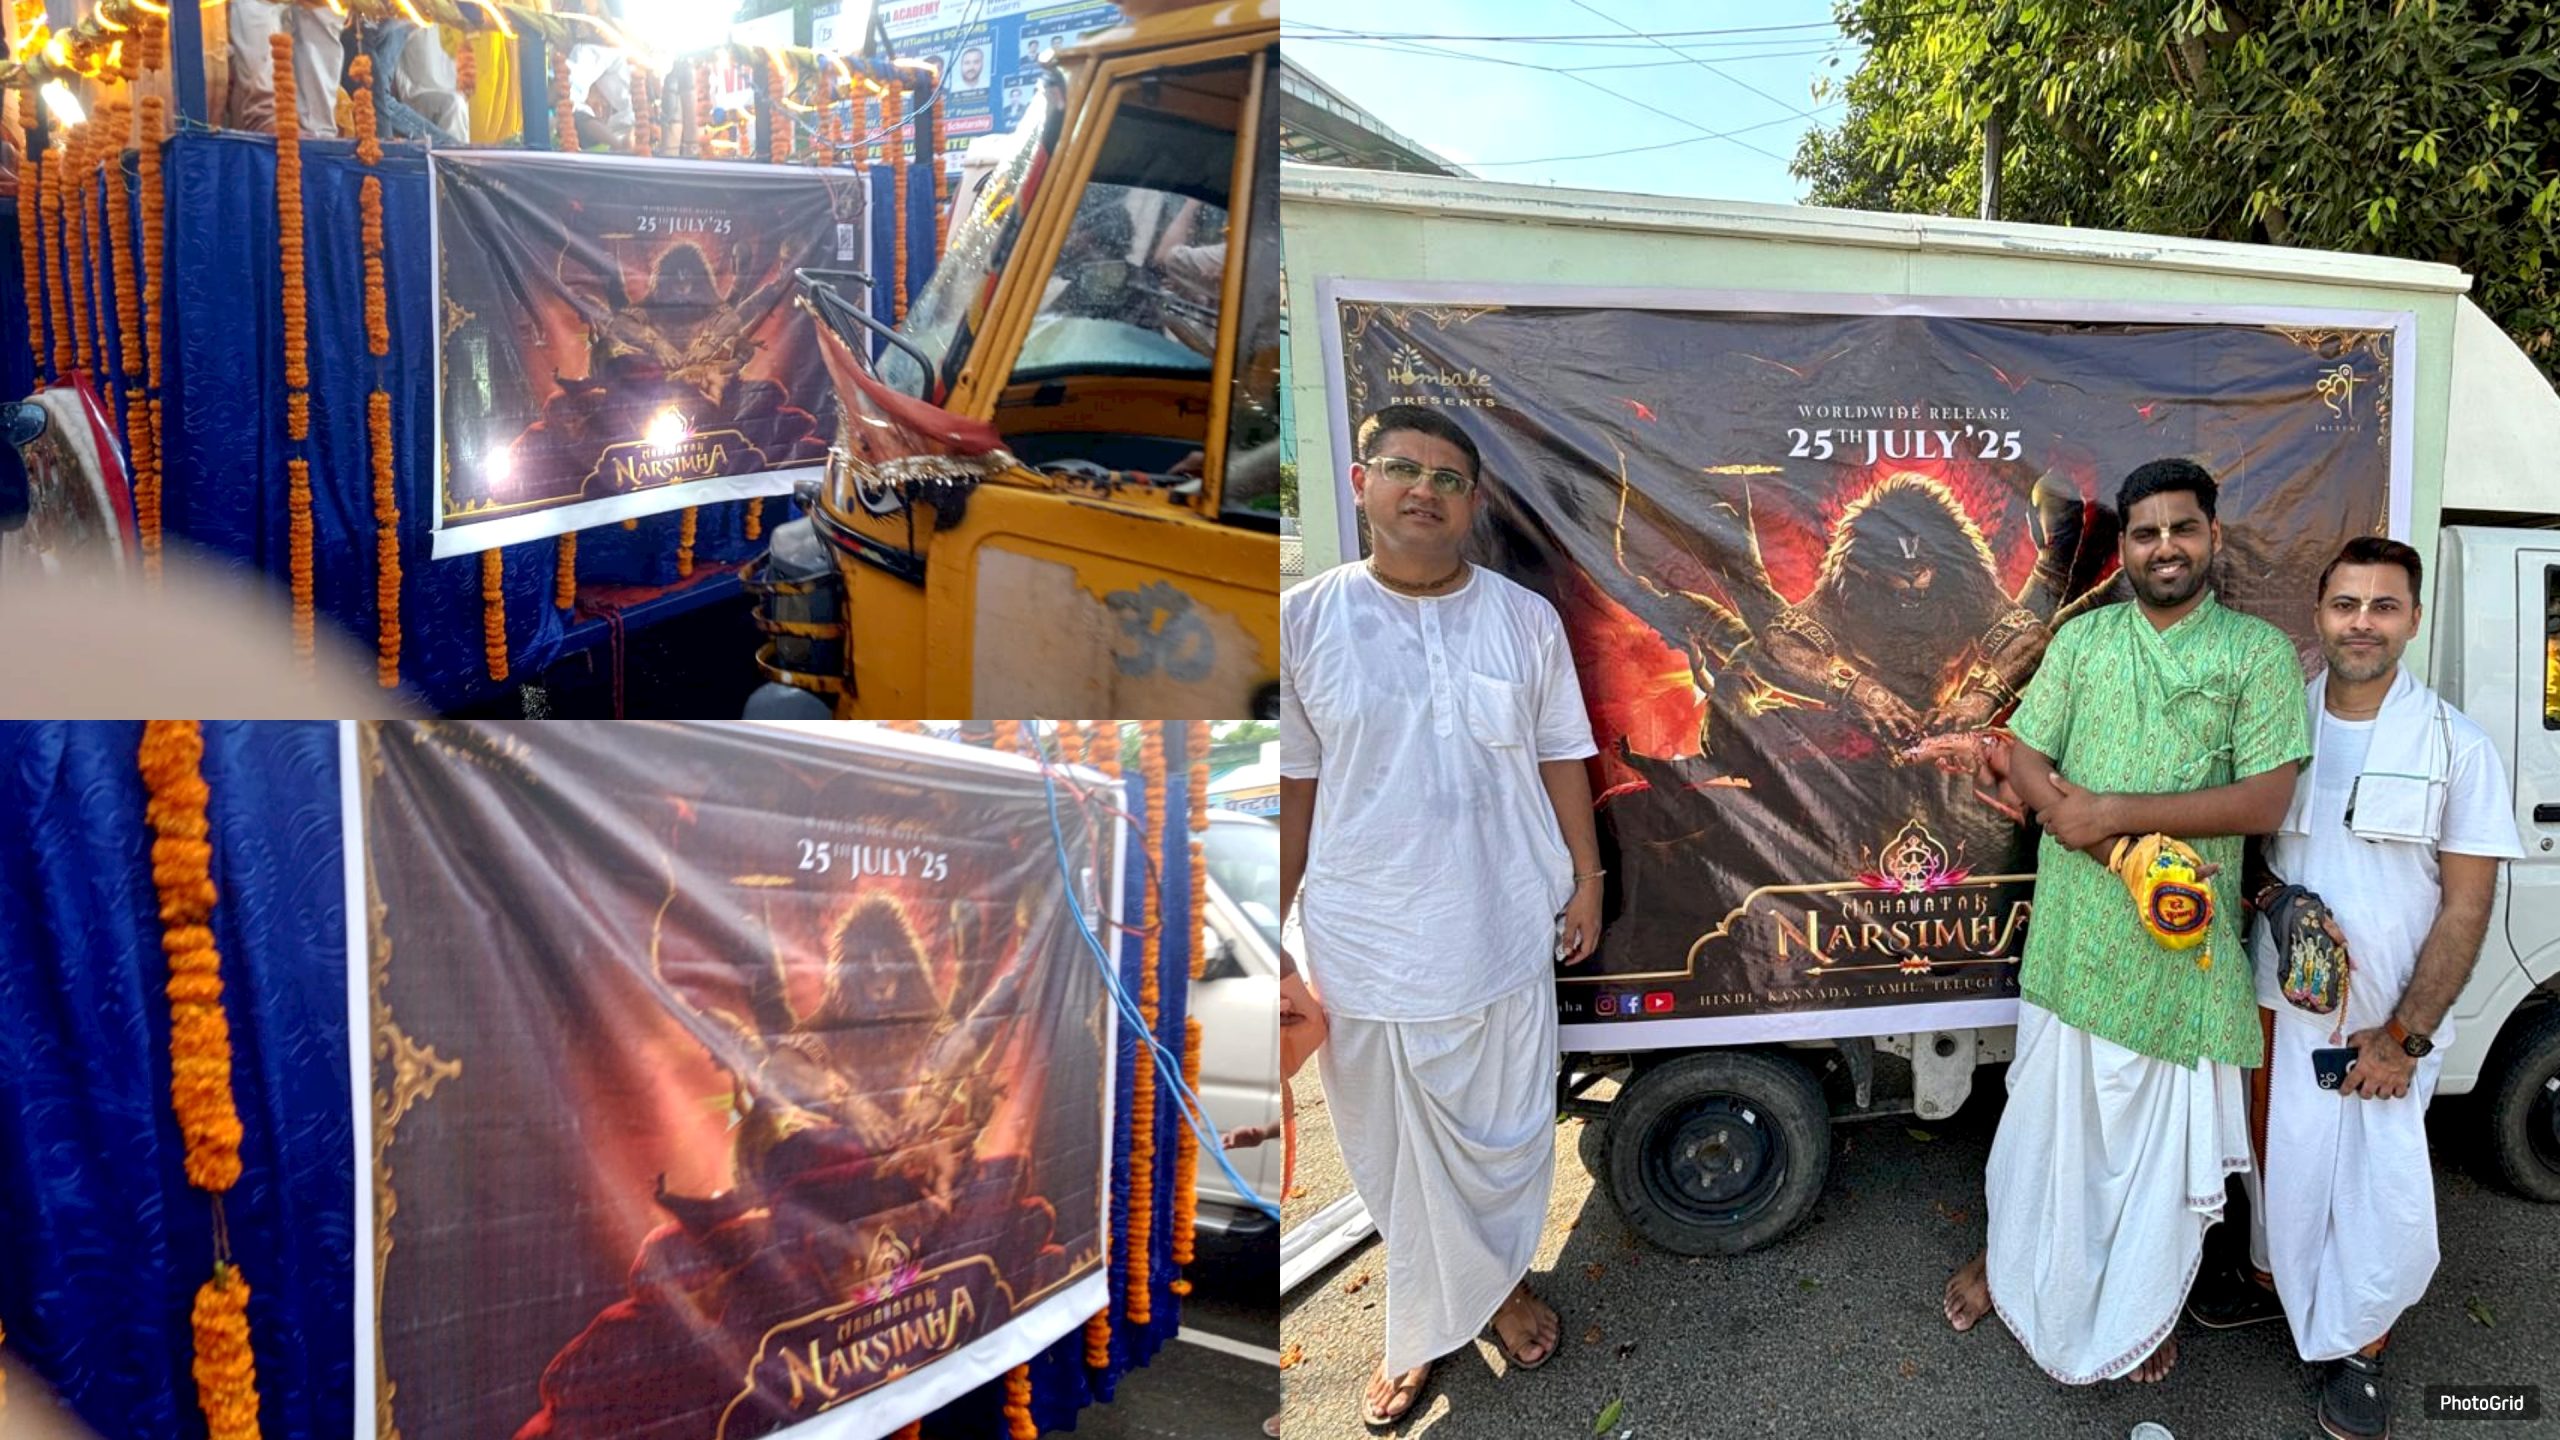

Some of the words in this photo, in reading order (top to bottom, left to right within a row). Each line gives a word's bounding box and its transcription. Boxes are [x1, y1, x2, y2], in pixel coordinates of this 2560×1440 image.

[893, 1, 940, 22] ACADEMY
[1391, 395, 1496, 408] PRESENTS
[1798, 404, 1922, 420] WORLDWIDE
[1929, 406, 2011, 420] RELEASE
[612, 443, 729, 488] NARSIMHA
[1931, 977, 1998, 992] TELUGU
[778, 1284, 976, 1411] NARSIMHA
